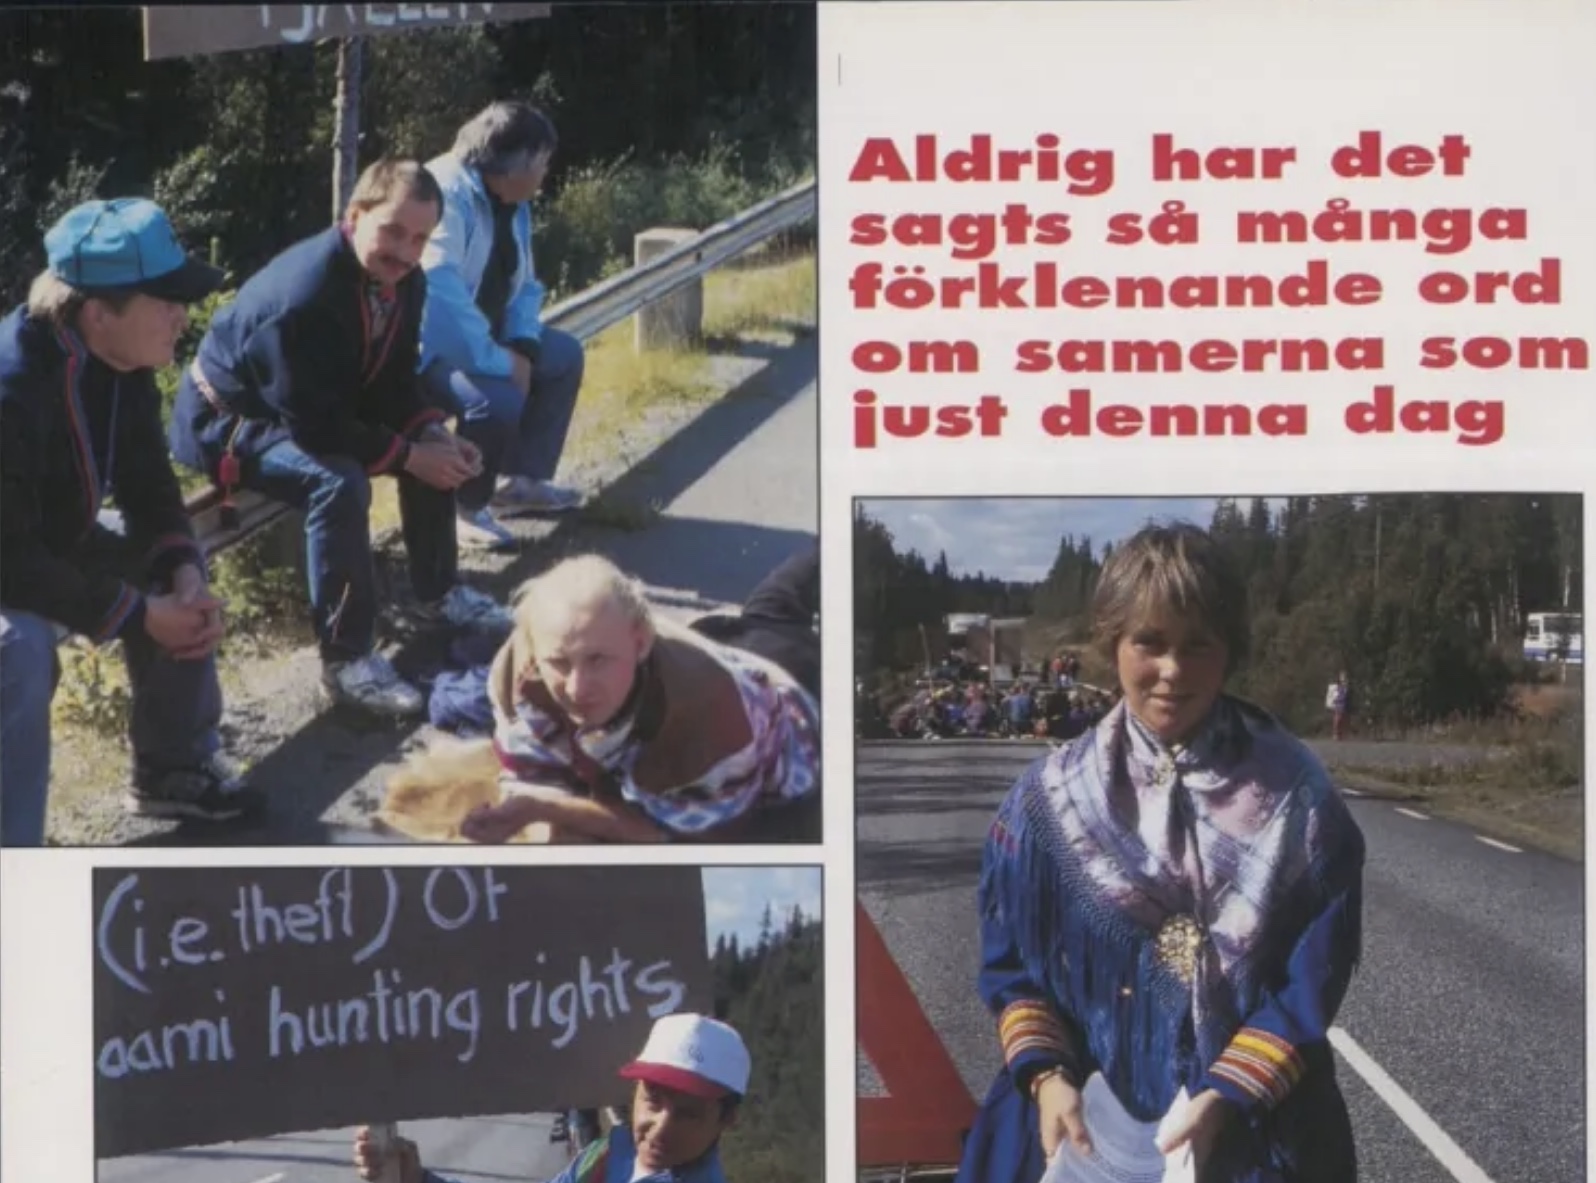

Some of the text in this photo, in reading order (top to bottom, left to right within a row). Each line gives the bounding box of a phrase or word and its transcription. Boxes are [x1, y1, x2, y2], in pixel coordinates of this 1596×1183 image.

[849, 130, 1472, 197] Aldrig har det
[850, 197, 1528, 261] sagts så många
[849, 258, 1561, 310] förklenande ord
[851, 335, 1589, 374] om samerna som
[853, 385, 1504, 449] just denna dag
[96, 948, 686, 1080] aami hunting rights
